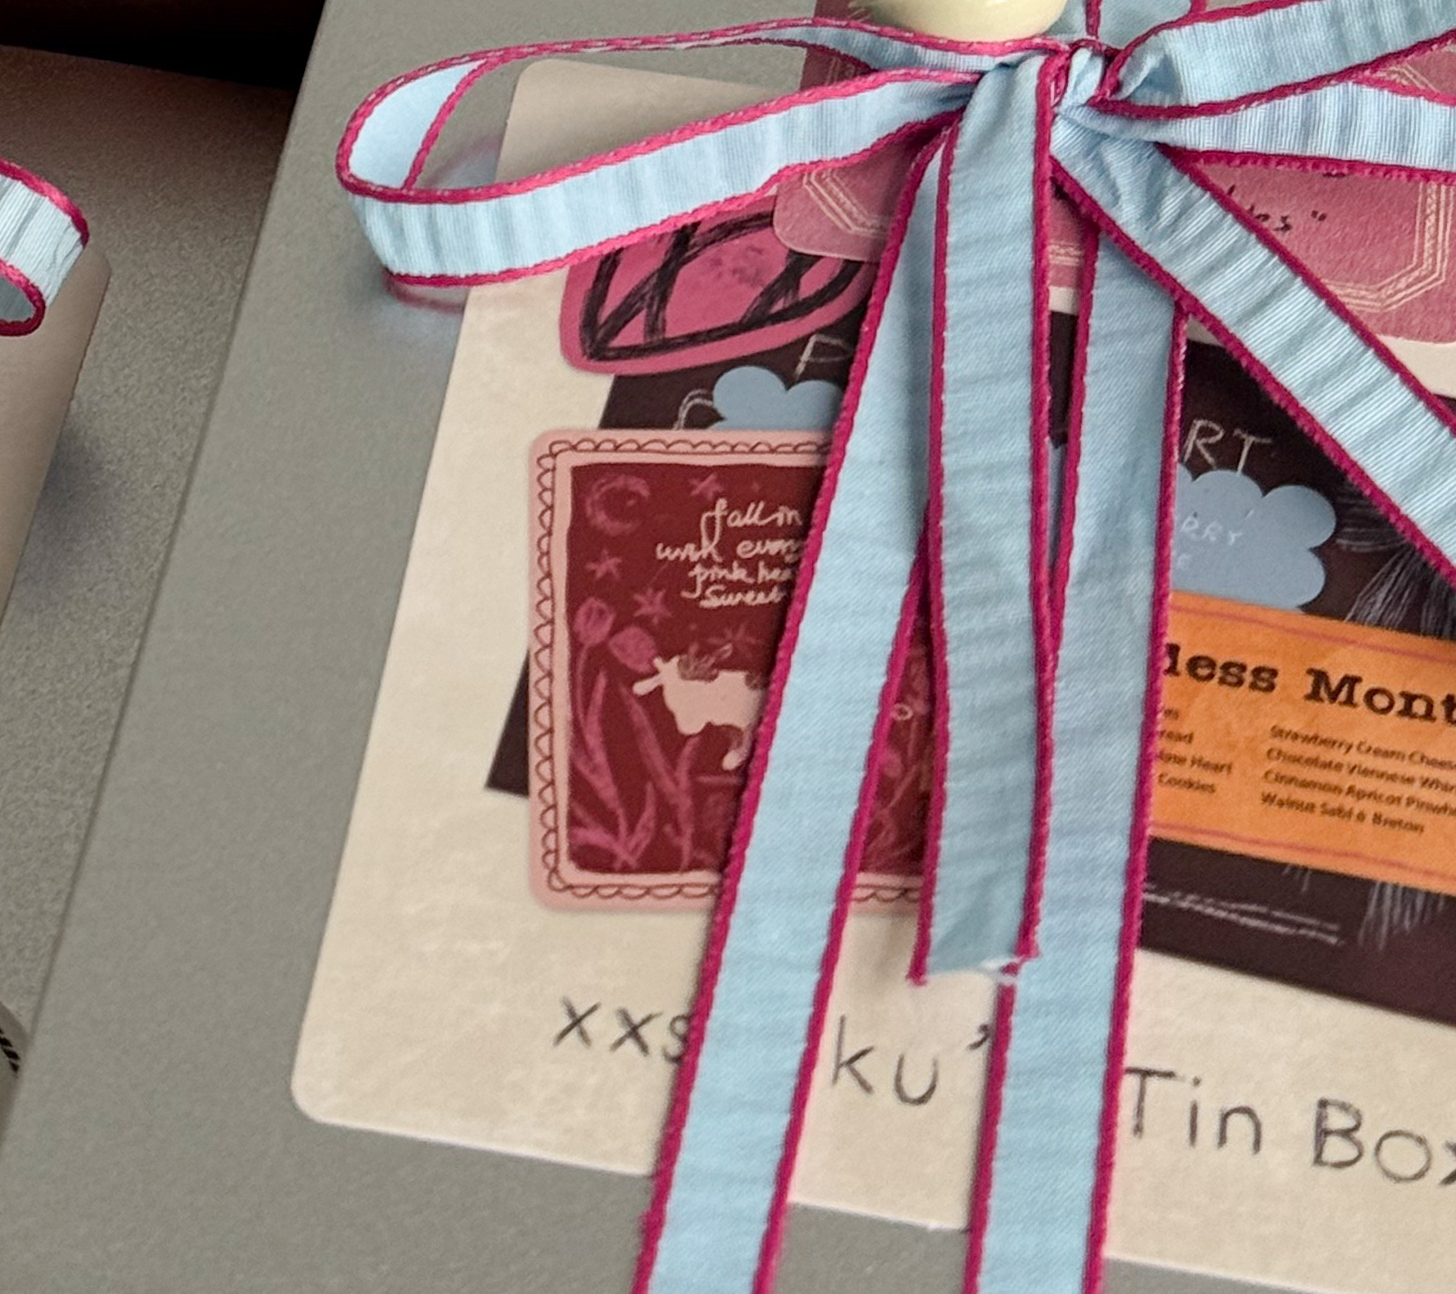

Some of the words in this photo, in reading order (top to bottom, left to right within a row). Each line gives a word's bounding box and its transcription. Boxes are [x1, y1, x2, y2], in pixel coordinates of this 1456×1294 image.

[1269, 723, 1354, 754] Strawberry
[1355, 741, 1406, 761] Cream
[1265, 746, 1344, 774] Chocolate
[1347, 763, 1417, 786] Viennese
[1263, 769, 1344, 797] Cinnamon
[1345, 785, 1404, 809] Apricot
[1261, 791, 1316, 813] Walnut
[1371, 807, 1426, 835] Breton
[1125, 1064, 1264, 1158] Tin
